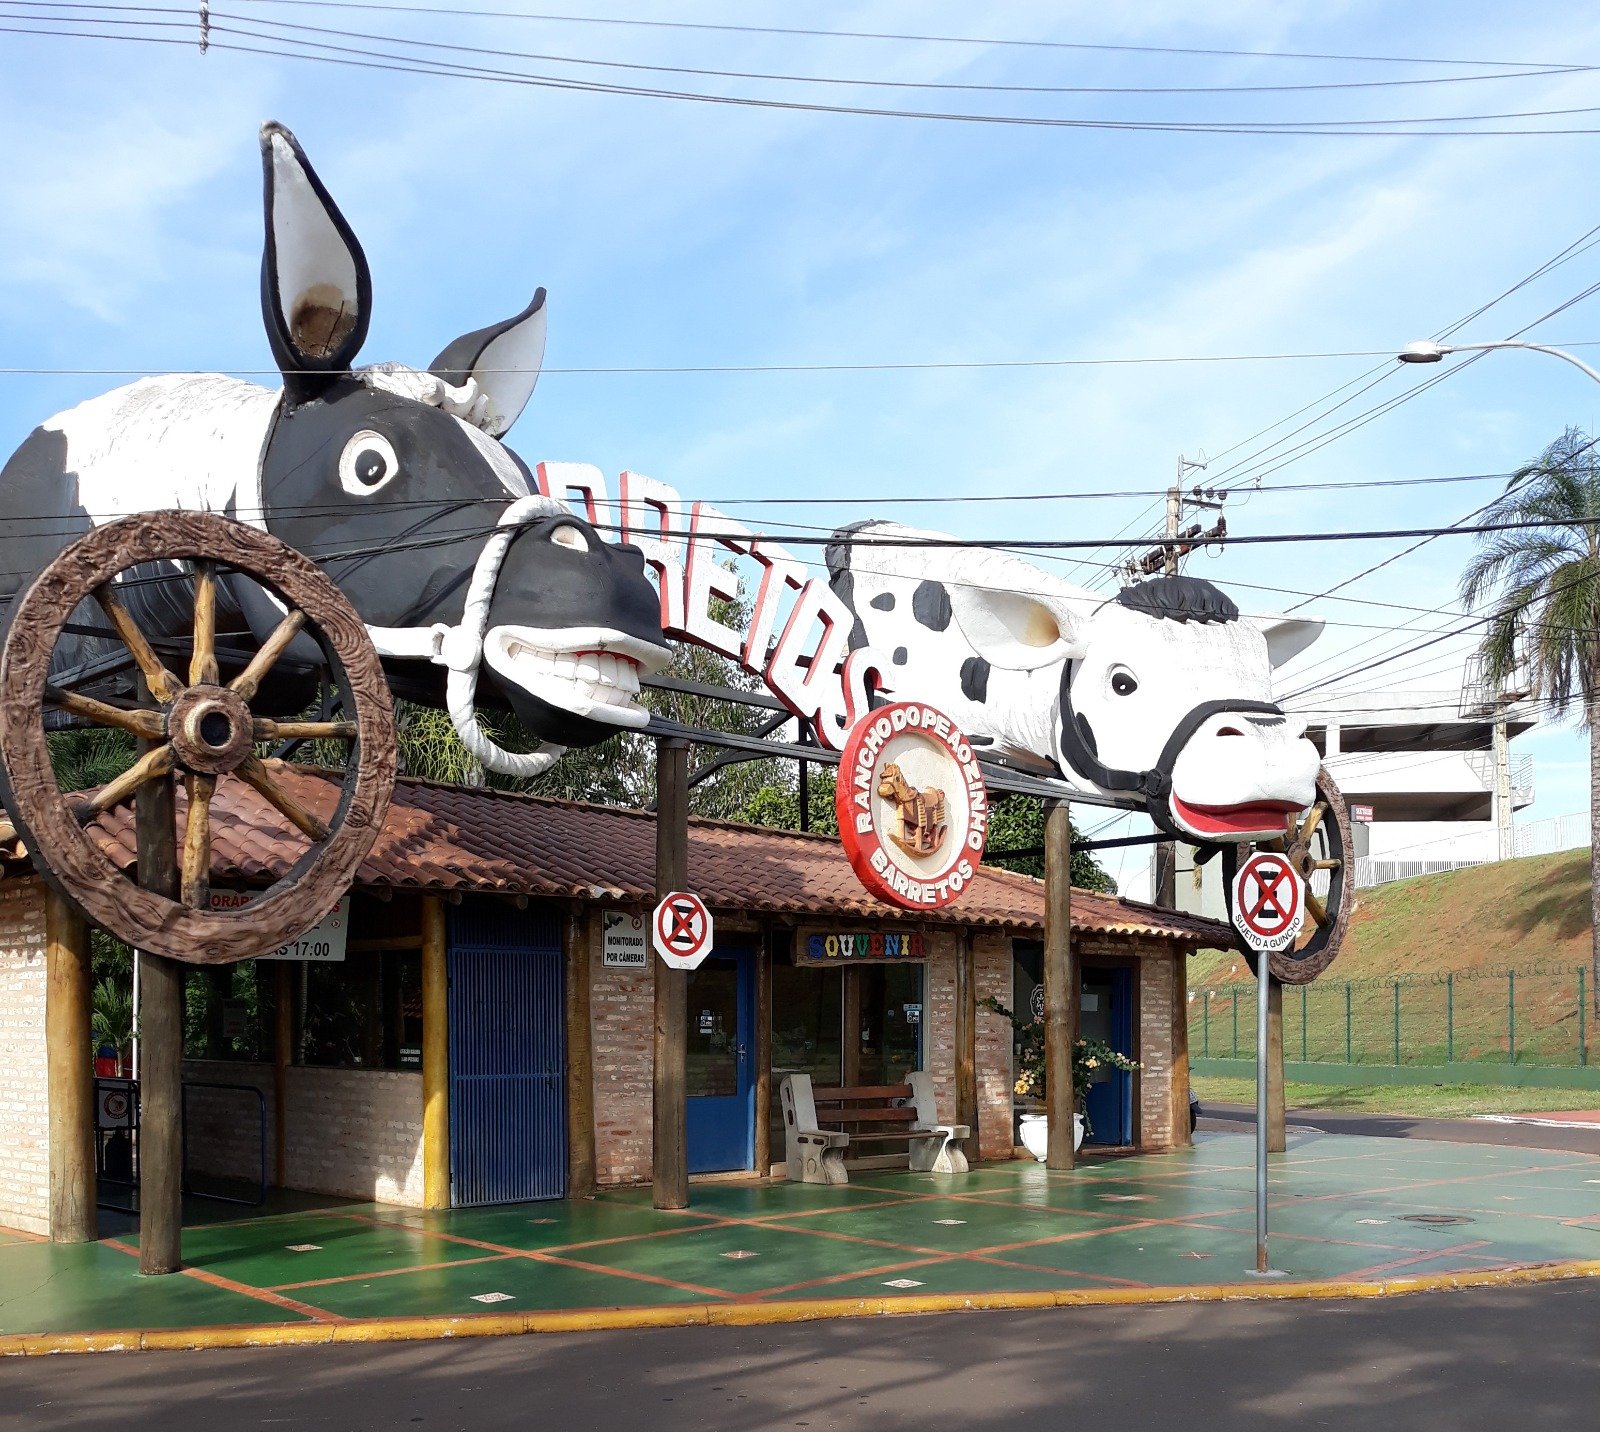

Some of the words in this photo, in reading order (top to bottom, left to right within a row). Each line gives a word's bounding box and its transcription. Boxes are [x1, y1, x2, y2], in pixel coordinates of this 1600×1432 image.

[854, 717, 892, 834] RANCHO
[889, 705, 921, 732] DO
[869, 846, 974, 904] BARRETOS
[607, 935, 643, 947] MONITORADO
[1235, 914, 1262, 946] SUJEITO
[1262, 940, 1269, 948] A
[1269, 917, 1301, 948] GUINCHO
[294, 942, 330, 957] 17:00
[606, 952, 618, 962] POR
